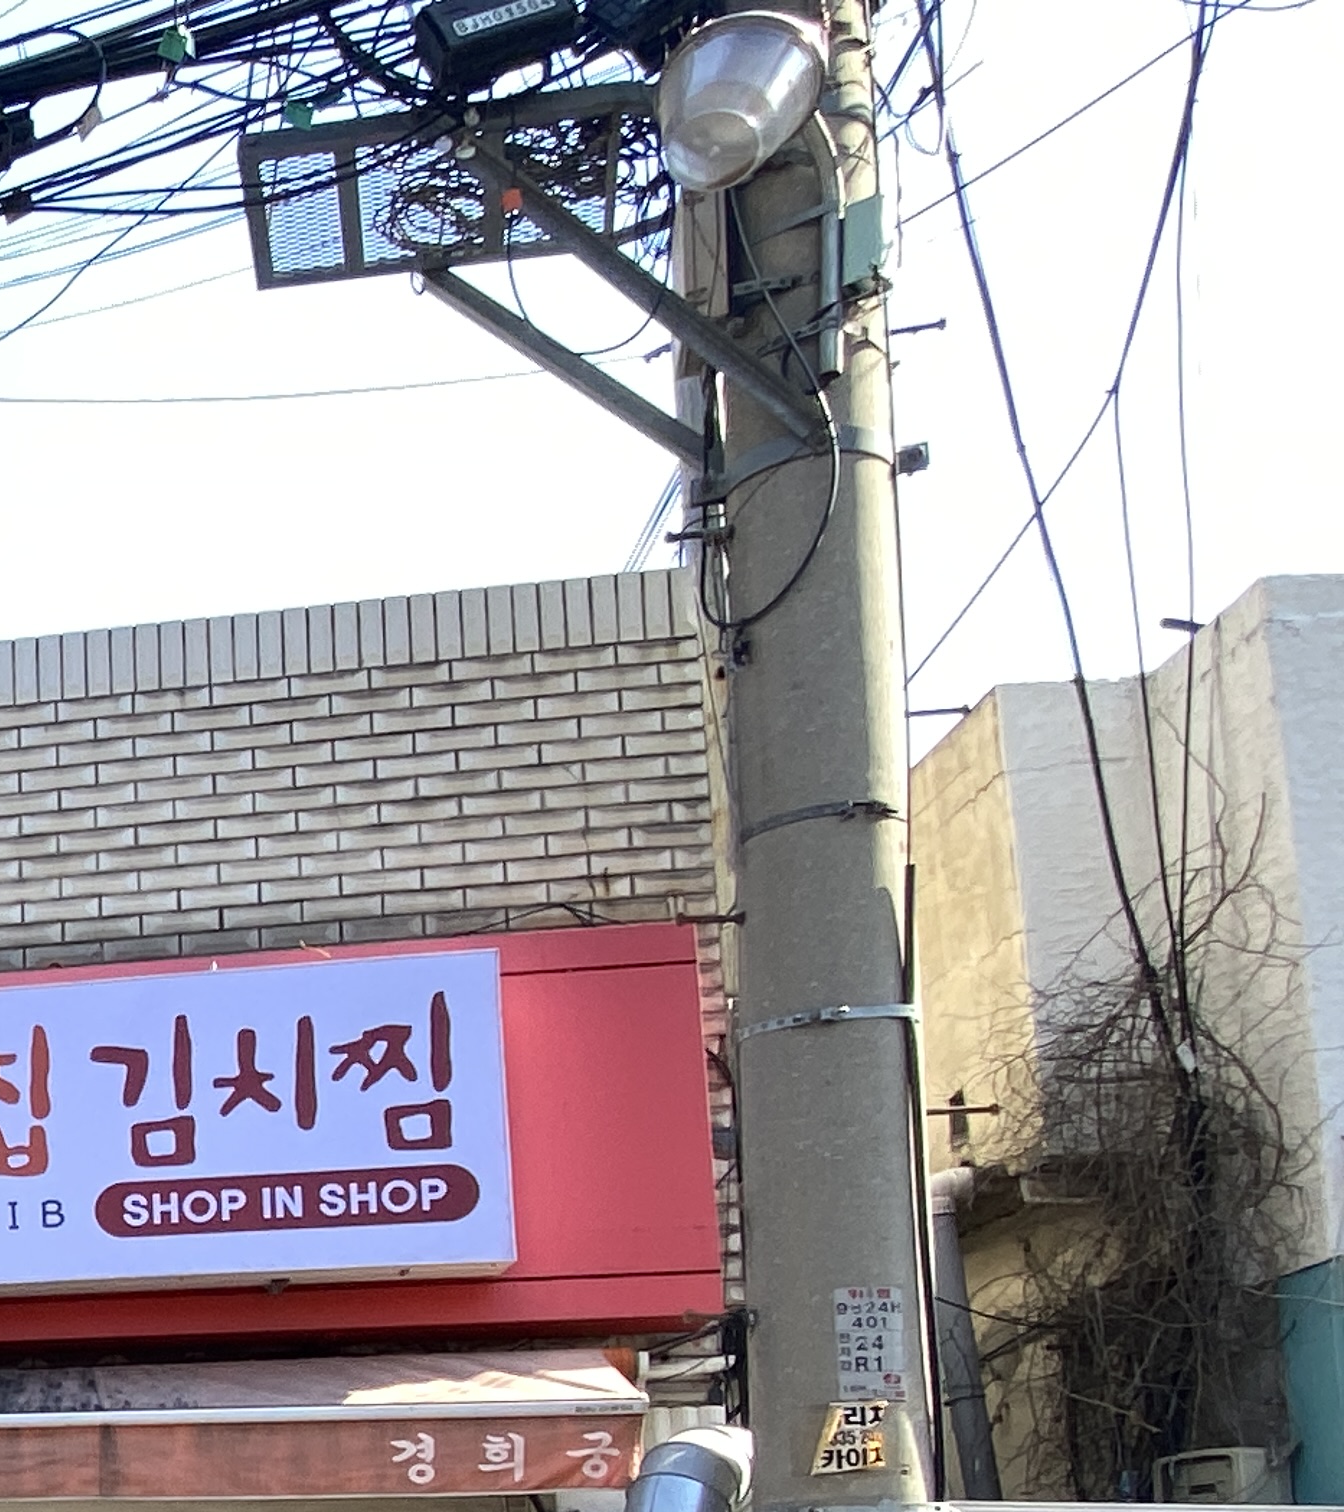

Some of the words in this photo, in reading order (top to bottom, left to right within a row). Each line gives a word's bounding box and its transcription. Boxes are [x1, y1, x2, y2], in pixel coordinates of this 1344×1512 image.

[90, 989, 454, 1168] 김치찜
[123, 1186, 248, 1228] SHOP
[260, 1184, 305, 1218] IN
[318, 1177, 449, 1216] SHOP
[389, 1431, 621, 1485] 경희궁
